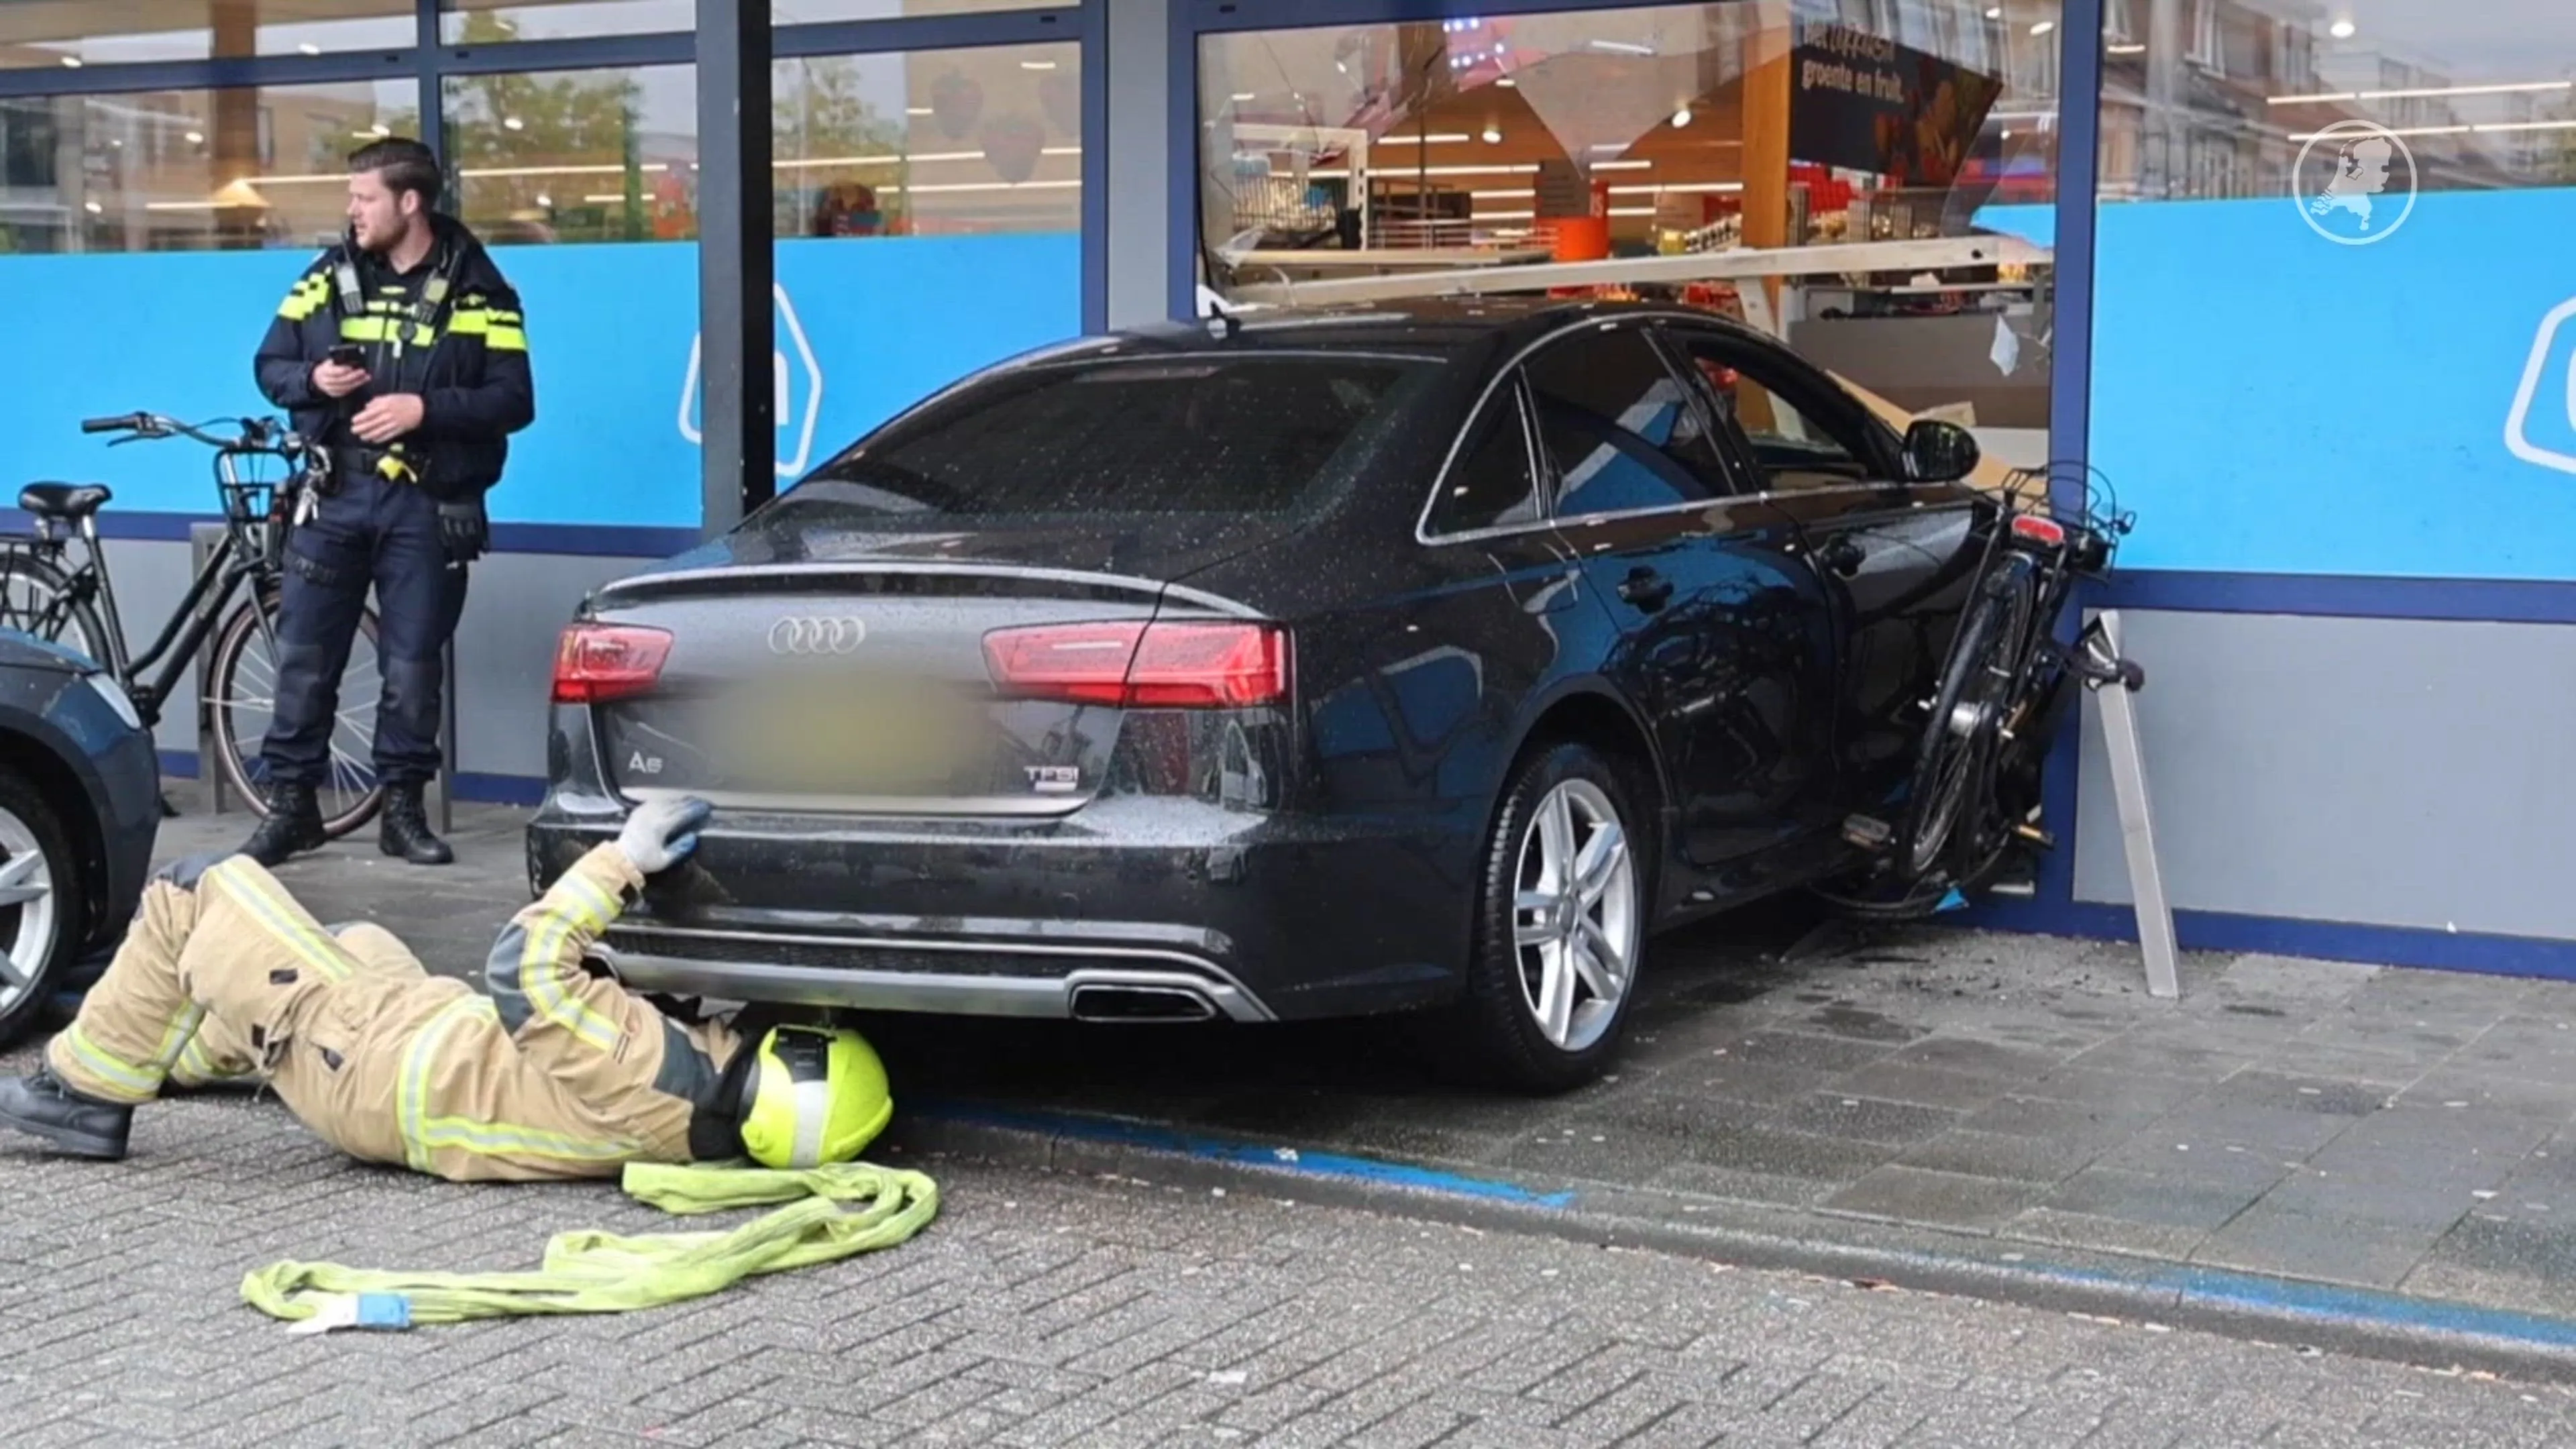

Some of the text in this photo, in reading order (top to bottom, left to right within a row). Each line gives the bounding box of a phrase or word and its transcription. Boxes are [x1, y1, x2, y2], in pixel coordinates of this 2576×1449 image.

[1801, 59, 1853, 91] groente
[1856, 71, 1872, 97] en
[627, 749, 663, 773] A6
[1023, 765, 1079, 782] TFSI
